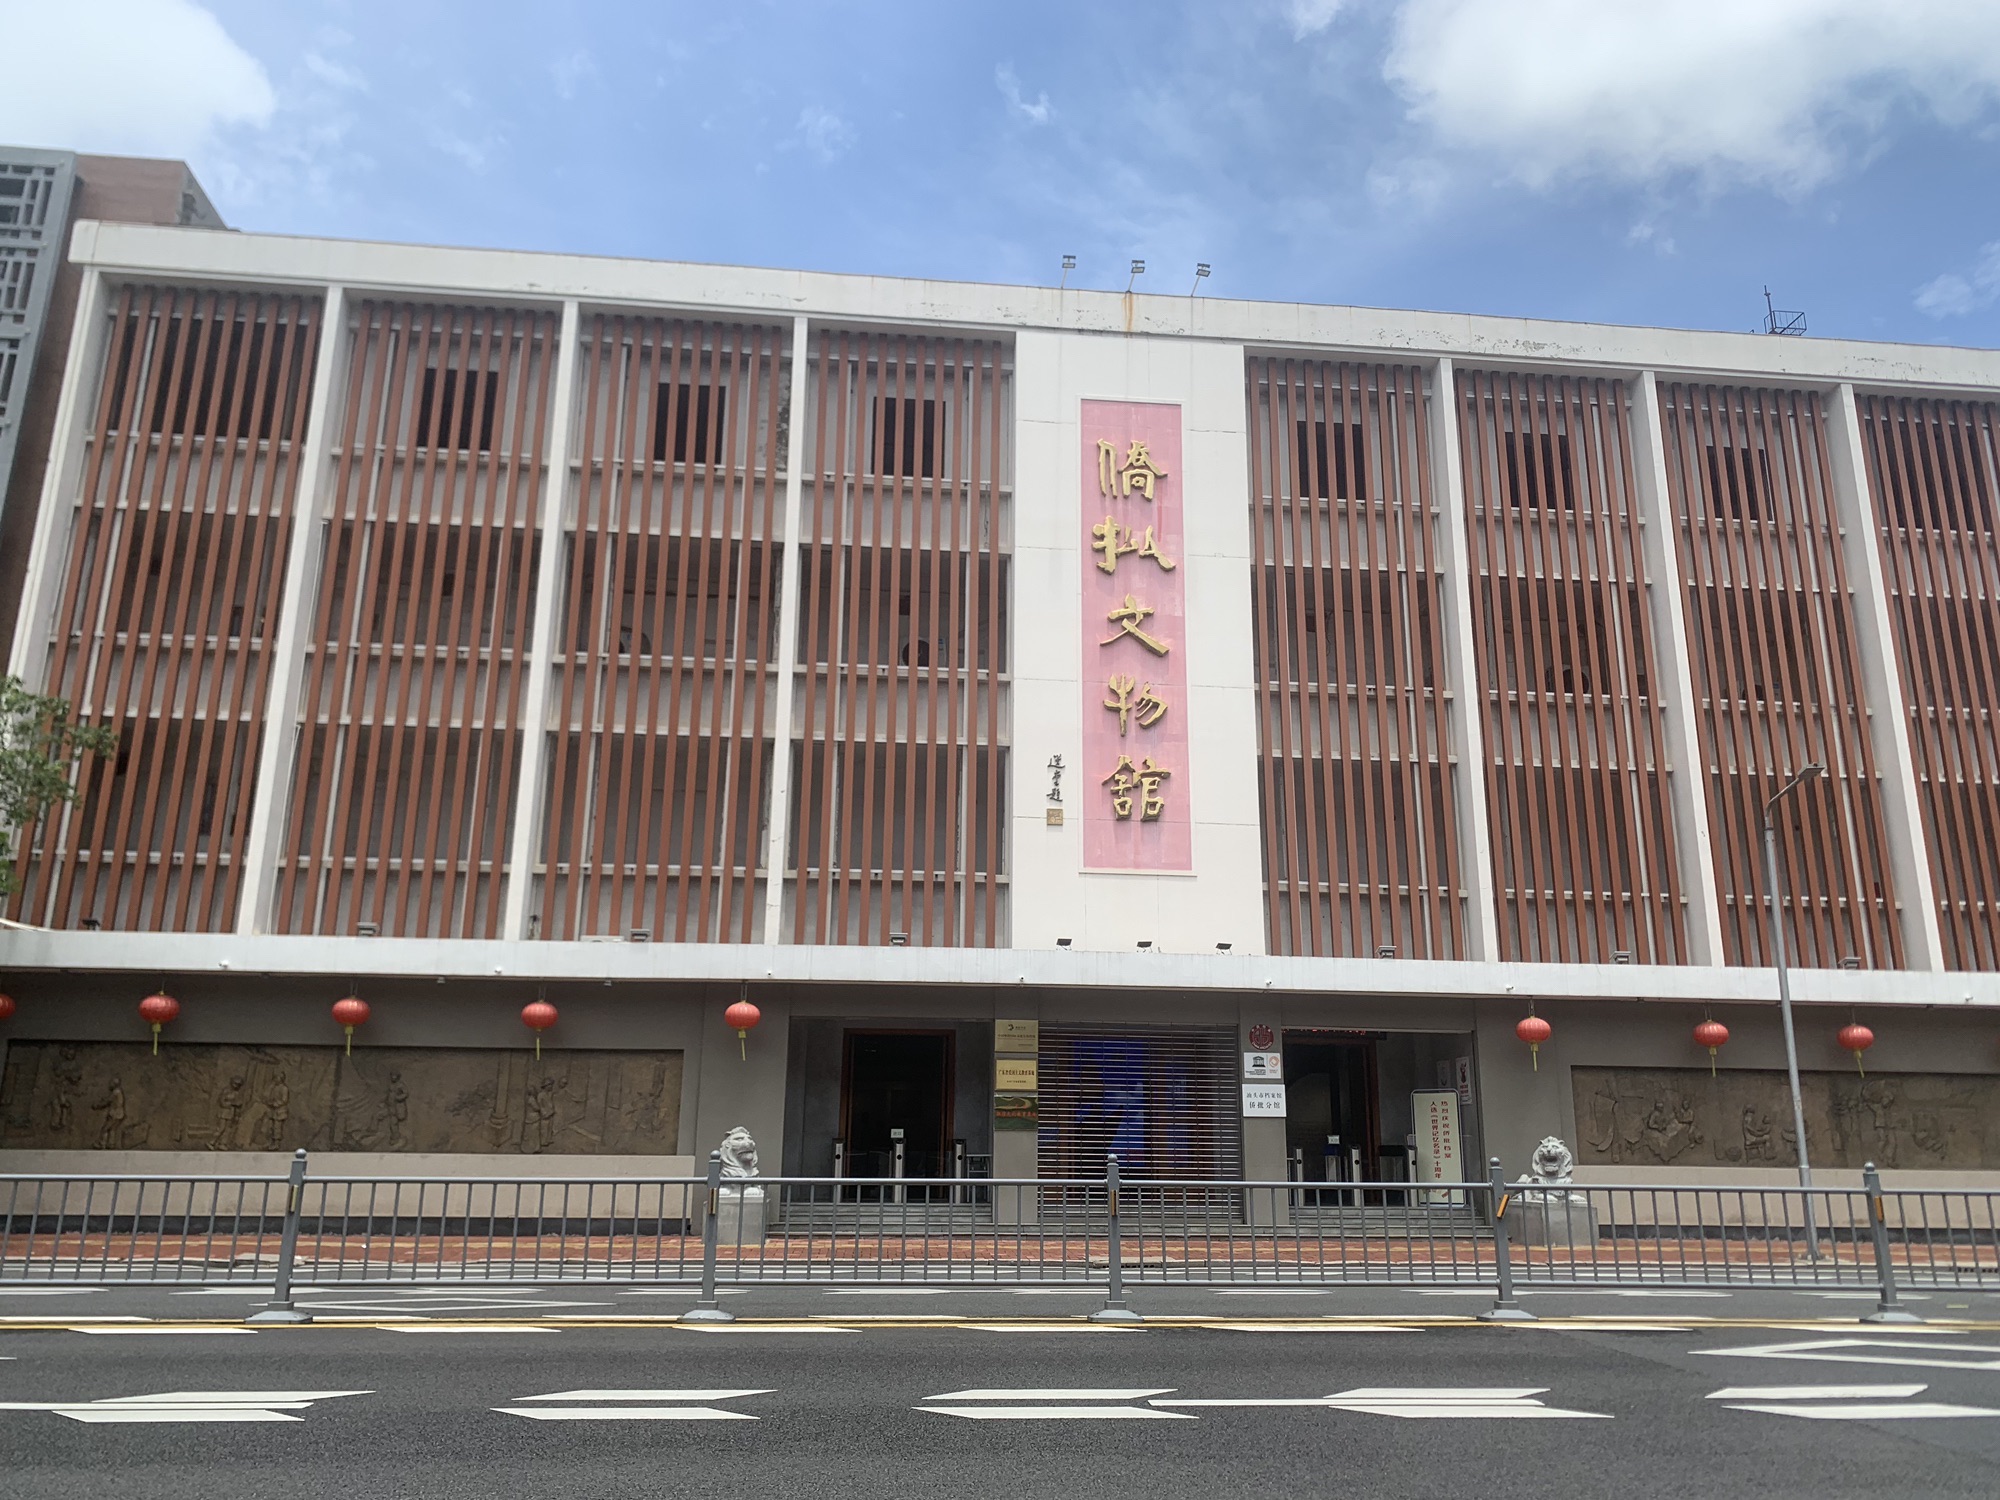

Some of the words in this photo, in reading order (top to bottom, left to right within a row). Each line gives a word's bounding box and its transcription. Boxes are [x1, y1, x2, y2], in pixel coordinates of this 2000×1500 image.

[1249, 1101, 1281, 1109] 侨批分馆
[1440, 1100, 1452, 1159] 热烈庆祝侨批档案
